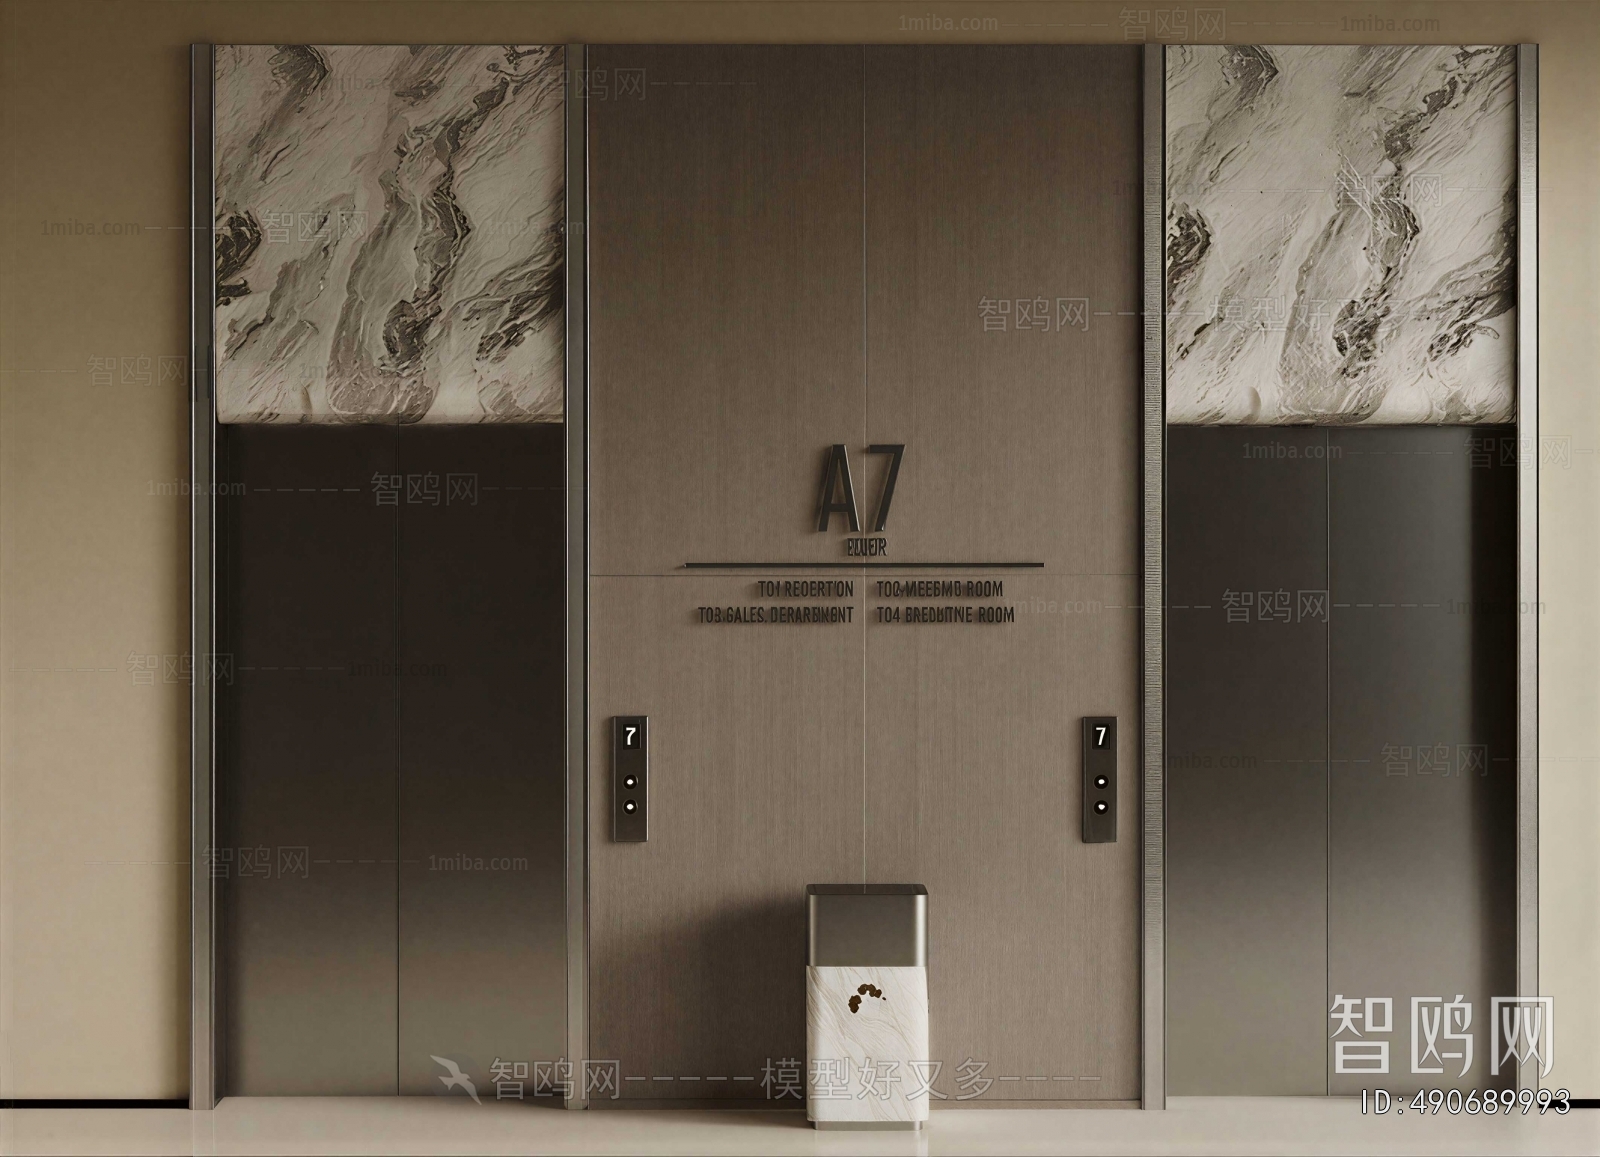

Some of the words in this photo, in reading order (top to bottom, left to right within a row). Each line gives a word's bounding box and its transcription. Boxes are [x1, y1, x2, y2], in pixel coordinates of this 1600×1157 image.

[967, 580, 1004, 597] ROOM
[979, 606, 1015, 623] ROOM
[625, 726, 636, 746] 7
[1095, 726, 1107, 746] 7
